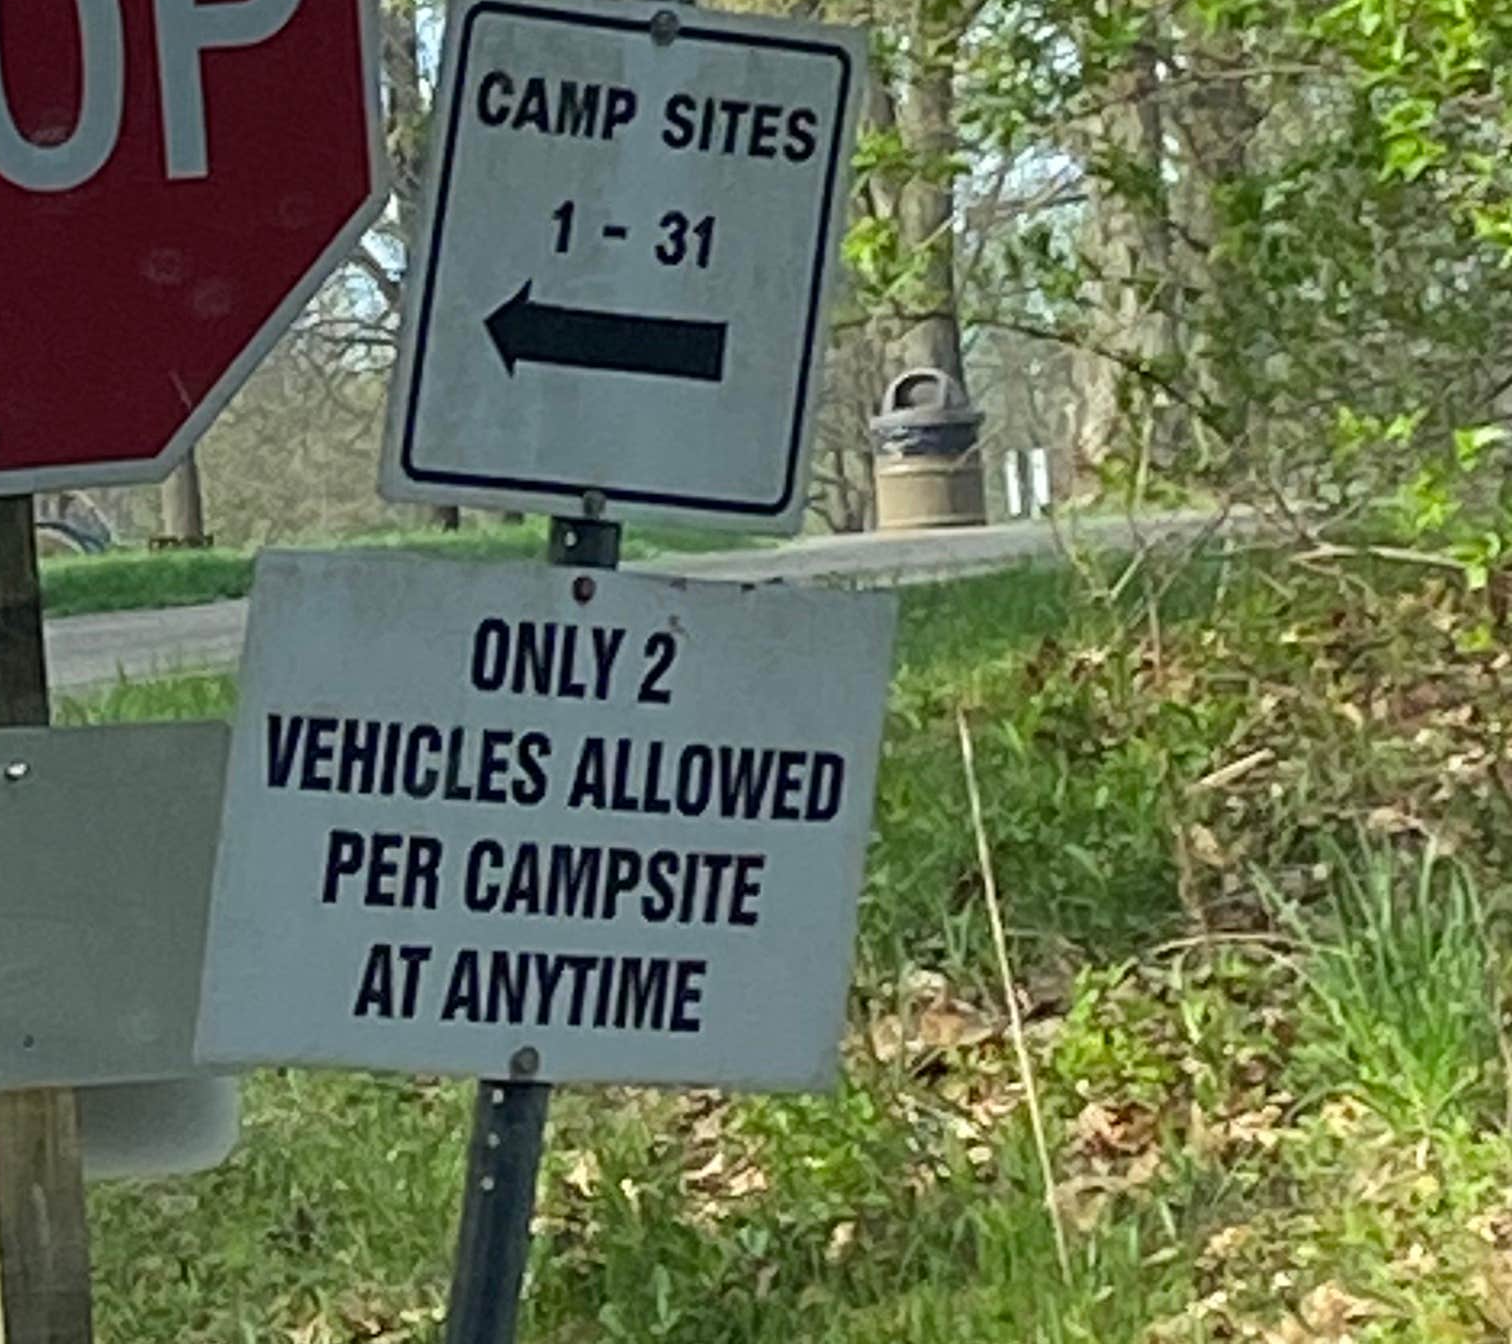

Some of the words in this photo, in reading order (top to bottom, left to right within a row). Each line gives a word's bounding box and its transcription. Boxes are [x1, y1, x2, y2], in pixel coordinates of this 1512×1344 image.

[476, 69, 637, 141] CAMP
[661, 93, 818, 164] SITES
[552, 199, 575, 254] 1
[654, 210, 716, 269] 31
[470, 617, 627, 701] ONLY
[637, 631, 678, 705] 2
[266, 713, 552, 806] VEHICLES
[567, 736, 846, 822] ALLOWED
[321, 828, 444, 910] PER
[464, 838, 766, 927] CAMPSITE
[353, 943, 434, 1019] AT
[440, 948, 708, 1033] ANYTIME
